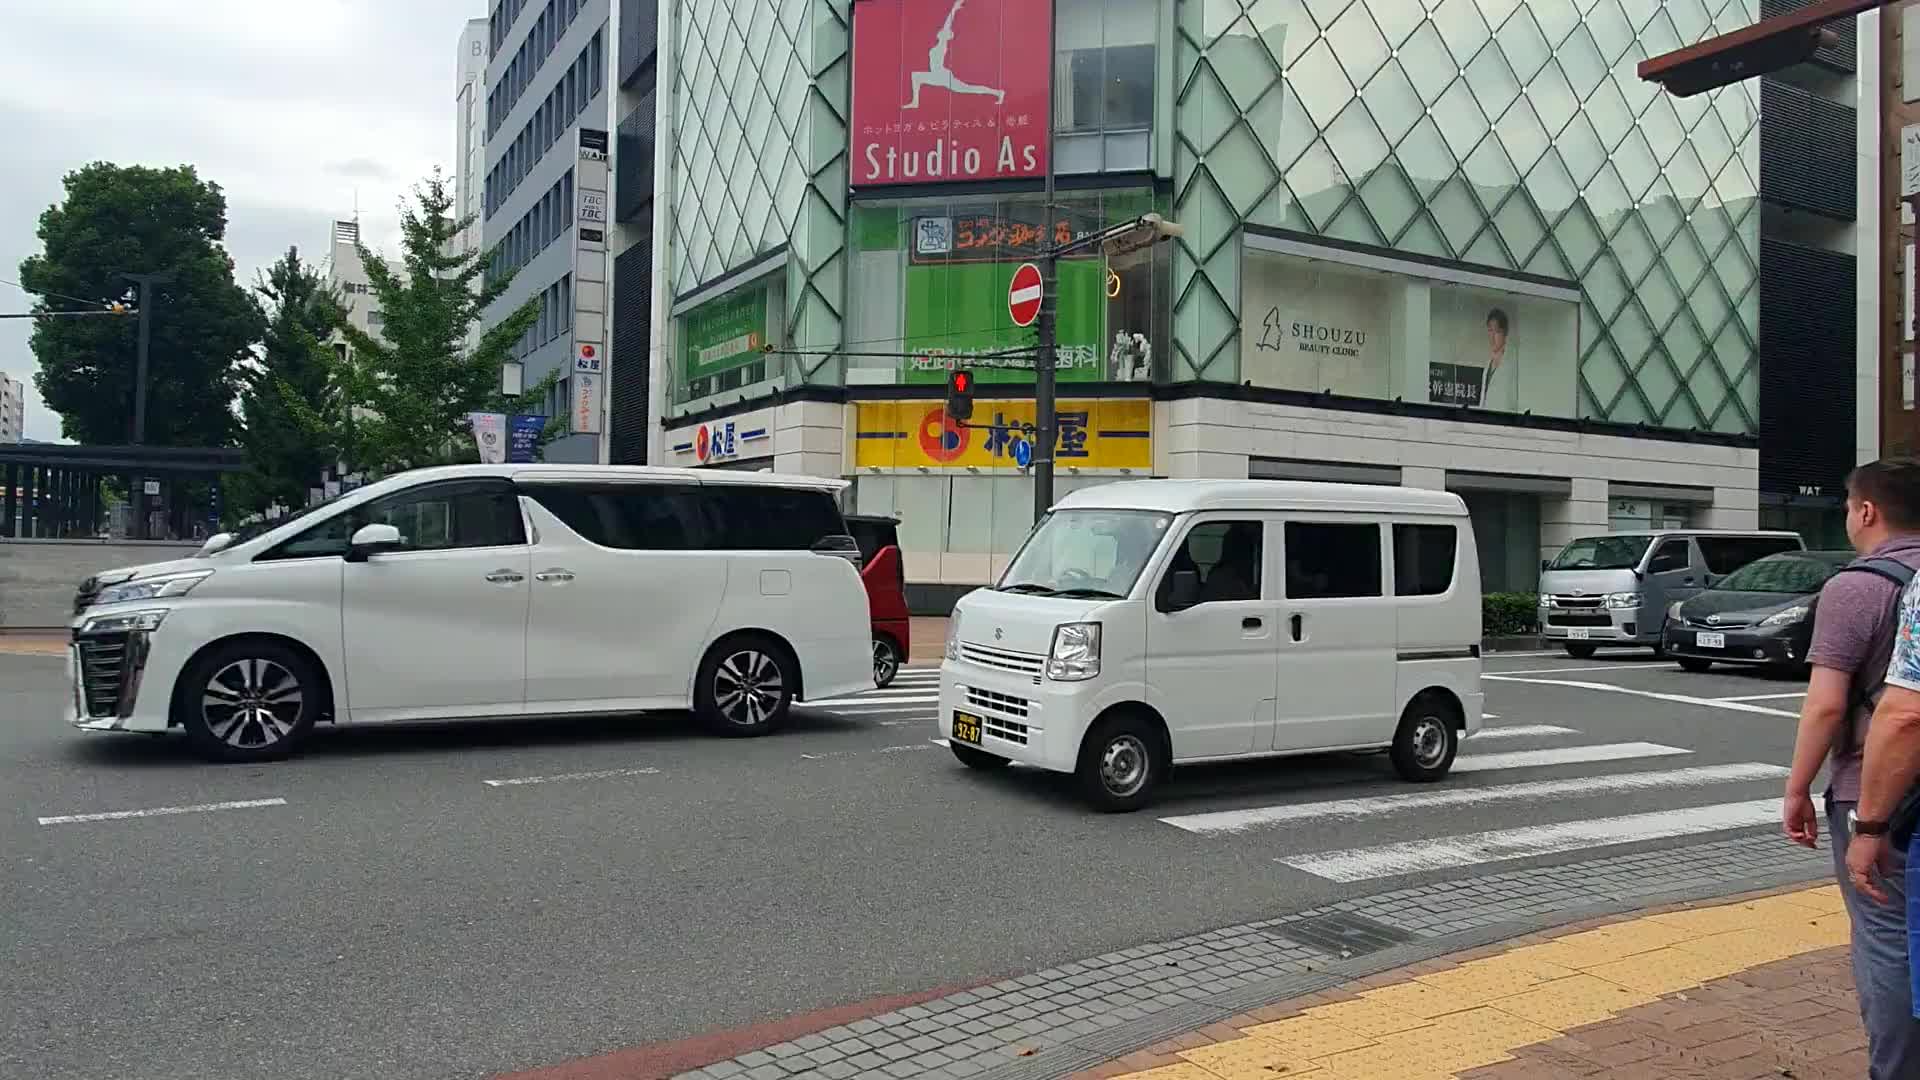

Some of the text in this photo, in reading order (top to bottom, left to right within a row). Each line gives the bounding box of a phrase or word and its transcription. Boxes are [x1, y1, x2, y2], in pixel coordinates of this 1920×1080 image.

[865, 135, 1037, 180] Studio As
[581, 208, 602, 220] TBC
[1291, 322, 1366, 346] SHOUZU
[1299, 342, 1360, 357] BEAUTY CLINIC
[711, 422, 736, 456] 松屋
[983, 411, 1090, 457] 松屋
[1799, 486, 1820, 497] WAT
